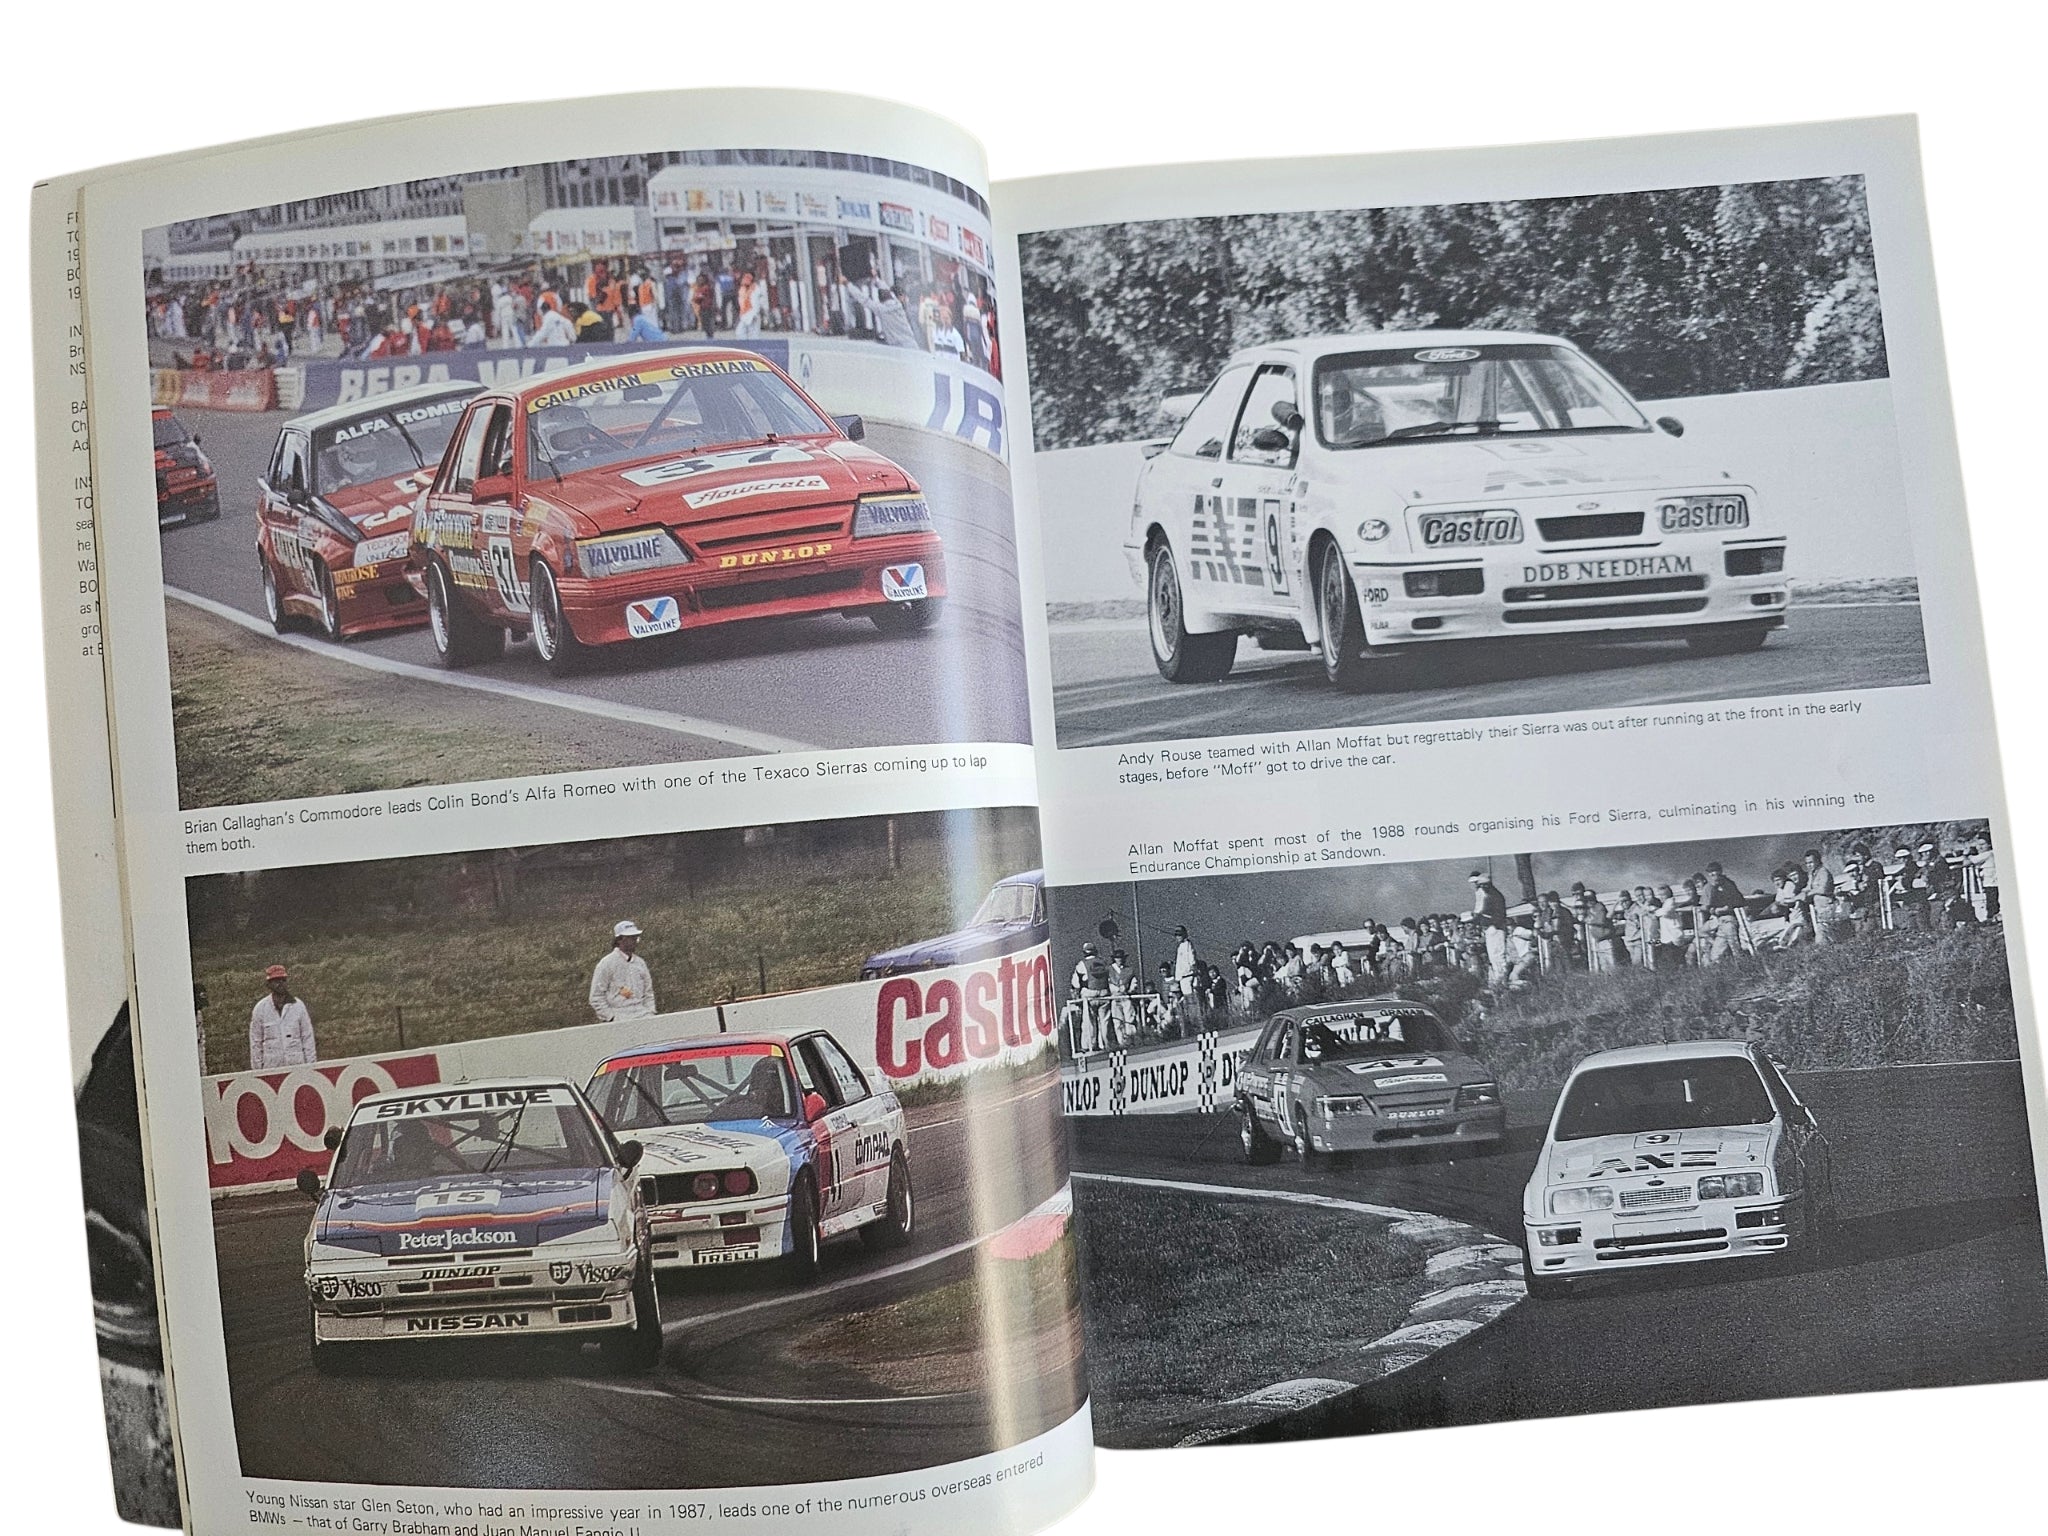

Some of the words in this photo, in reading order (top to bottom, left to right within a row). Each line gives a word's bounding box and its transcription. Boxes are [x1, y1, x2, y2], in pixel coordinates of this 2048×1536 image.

[535, 374, 642, 410] CALLAGHAN
[671, 361, 757, 379] GRAHAM
[335, 418, 390, 444] ALFA
[644, 449, 780, 479] 37
[75, 496, 93, 510] TO
[868, 502, 930, 524] VALVOLINE
[1660, 501, 1744, 530] Castrol
[1424, 516, 1518, 546] Castrol
[77, 540, 91, 551] he
[587, 537, 661, 567] VALVOLINE
[719, 543, 834, 569] DUNLOP
[1268, 513, 1282, 586] 9
[78, 559, 95, 572] Wa
[1523, 564, 1570, 583] DDB
[1577, 556, 1692, 582] NEEDHAM
[80, 579, 98, 594] BO
[80, 604, 92, 615] as
[81, 624, 100, 638] gro
[633, 616, 678, 636] VALVOLINE
[82, 645, 94, 656] at
[1118, 752, 1154, 765] Andy
[1161, 750, 1202, 762] Rouse
[1207, 744, 1254, 759] teamed
[1260, 742, 1290, 754] with
[1296, 740, 1331, 752] Allan
[1337, 735, 1382, 749] Moffat
[1387, 734, 1409, 745] but
[1414, 728, 1483, 745] regrettably
[1488, 725, 1518, 738] their
[1522, 724, 1559, 735] Sierra
[1563, 723, 1587, 732] was
[1592, 720, 1614, 730] out
[1618, 716, 1648, 728] after
[1653, 712, 1703, 726] running
[1707, 712, 1720, 722] at
[1725, 709, 1745, 720] the
[1750, 707, 1784, 719] front
[1789, 707, 1800, 716] in
[1804, 703, 1826, 715] the
[1830, 700, 1862, 713] early
[1120, 767, 1162, 784] stages,
[1166, 767, 1208, 779] before
[1213, 760, 1261, 775] "Moff"
[1267, 761, 1288, 775] got
[1292, 761, 1306, 771] to
[1310, 756, 1342, 769] drive
[1346, 755, 1369, 767] the
[1372, 755, 1395, 765] car.
[185, 820, 217, 834] Brian
[223, 811, 294, 831] Callaghan's
[300, 805, 382, 823] Commodore
[388, 799, 422, 814] leads
[428, 795, 463, 810] Colin
[471, 789, 519, 806] Bond's
[525, 786, 555, 801] Alfa
[563, 784, 616, 798] Romeo
[622, 777, 656, 792] with
[664, 777, 691, 788] one
[698, 771, 715, 785] of
[721, 770, 746, 783] the
[753, 767, 809, 780] Texaco
[817, 762, 867, 776] Sierras
[874, 757, 926, 772] coming
[932, 759, 948, 770] up
[952, 757, 966, 767] to
[970, 754, 987, 769] lap
[1128, 844, 1163, 856] Allan
[1174, 839, 1219, 853] Moffat
[1229, 837, 1264, 851] spent
[1275, 834, 1307, 846] most
[1317, 830, 1330, 843] of
[1340, 829, 1361, 841] the
[1372, 825, 1404, 839] 1988
[1415, 822, 1459, 835] rounds
[1469, 819, 1533, 833] organising
[1542, 816, 1560, 826] his
[1569, 812, 1600, 824] Ford
[1609, 809, 1650, 821] Sierra,
[1659, 802, 1736, 817] culminating
[1745, 803, 1757, 811] in
[1766, 800, 1784, 810] his
[1792, 794, 1845, 808] winning
[1853, 792, 1874, 803] the
[186, 833, 217, 854] them
[221, 836, 255, 851] both.
[1130, 860, 1200, 874] Endurance
[1205, 851, 1300, 869] Championship
[1304, 851, 1317, 862] at
[1321, 847, 1385, 860] Sandown.
[876, 946, 1056, 1078] Castrol
[1305, 1012, 1364, 1026] CALLAGHAN
[1130, 1061, 1189, 1103] DUNLOP
[377, 1089, 552, 1119] SKYLINE
[1388, 1109, 1445, 1119] DUNLOP
[434, 1191, 487, 1205] 15
[421, 1265, 500, 1280] DUNLOP
[553, 1264, 572, 1281] BP
[322, 1279, 339, 1295] BP
[341, 1278, 382, 1299] Visco
[407, 1313, 530, 1333] NISSAN
[246, 1490, 285, 1508] Young
[290, 1494, 329, 1510] Nissan
[333, 1499, 355, 1511] star
[361, 1498, 391, 1512] Glen
[395, 1500, 439, 1517] Seton,
[444, 1502, 473, 1516] who
[478, 1503, 503, 1517] had
[508, 1506, 525, 1518] an
[531, 1504, 604, 1521] impressive
[610, 1509, 640, 1522] year
[648, 1505, 661, 1519] in
[669, 1504, 712, 1520] 1987,
[719, 1503, 756, 1518] leads
[761, 1505, 790, 1516] one
[795, 1499, 811, 1514] of
[817, 1498, 842, 1512] the
[848, 1489, 926, 1509] numerous
[932, 1474, 991, 1497] overseas
[997, 1452, 1043, 1481] entered
[249, 1510, 286, 1525] BMWs
[306, 1511, 332, 1529] that
[334, 1517, 350, 1530] of
[352, 1518, 387, 1534] Garry
[393, 1519, 452, 1536] Brabham
[454, 1523, 478, 1536] and
[483, 1524, 514, 1536] Juan
[520, 1525, 569, 1536] Manuel
